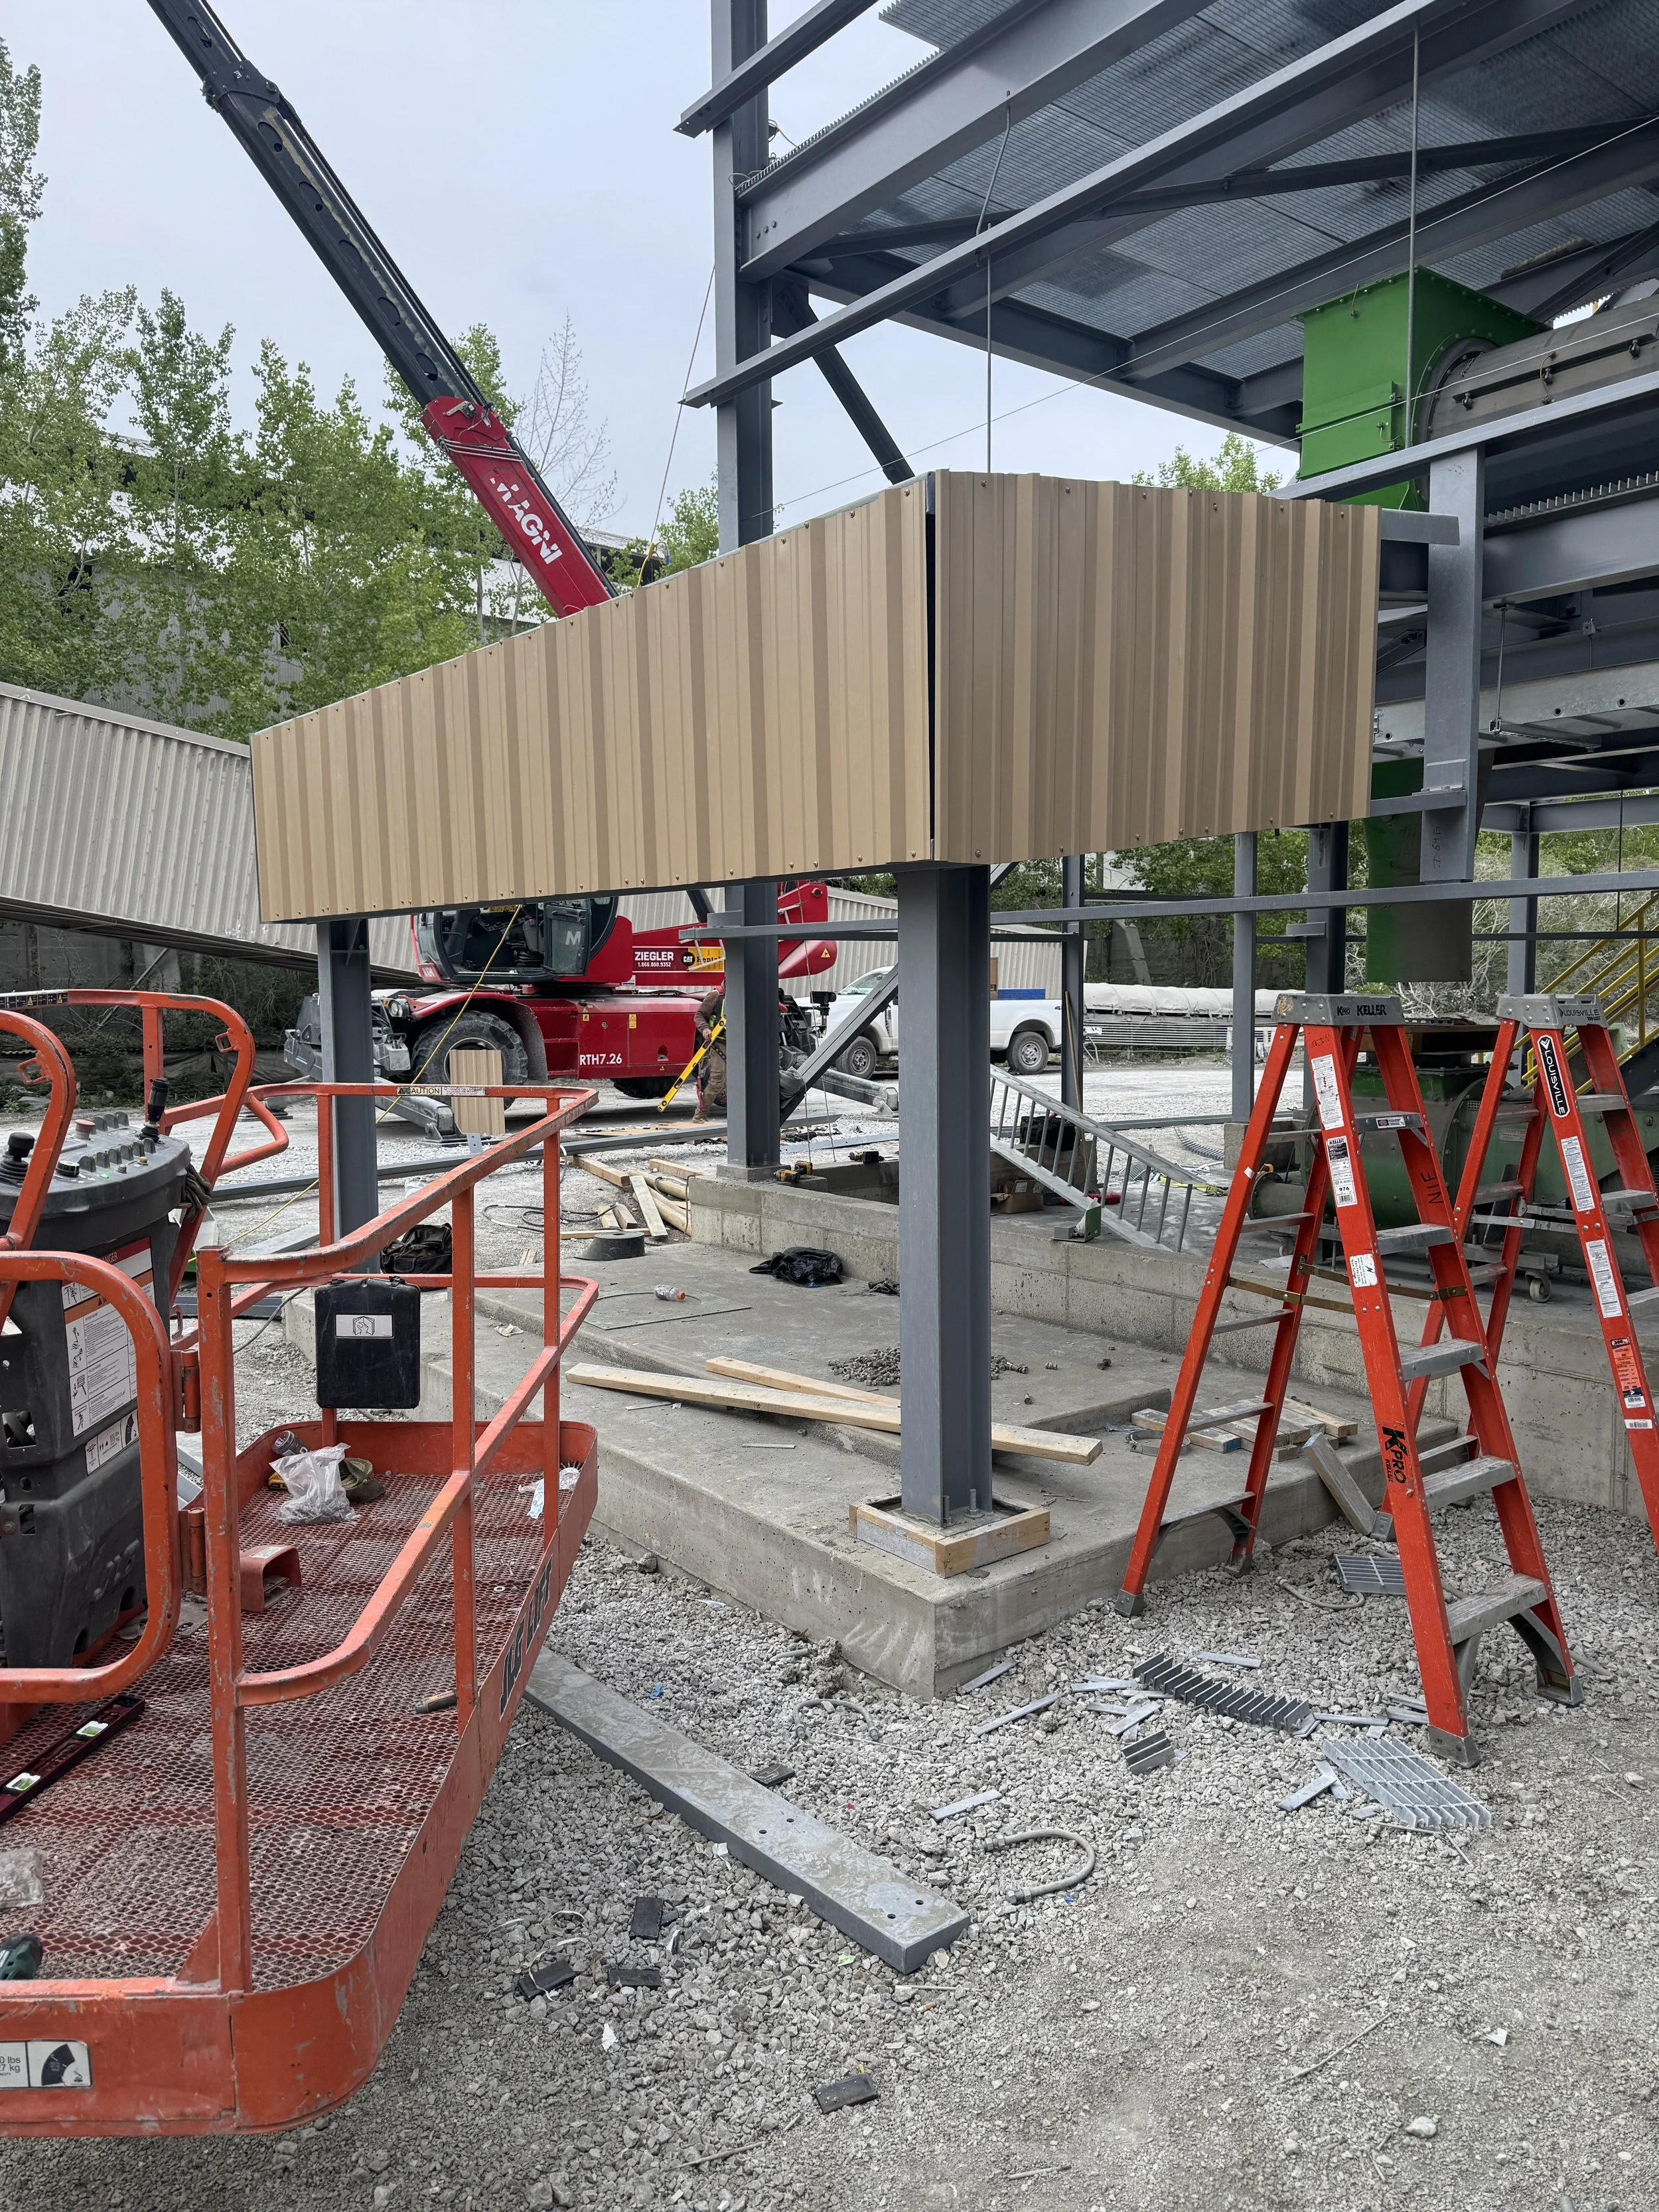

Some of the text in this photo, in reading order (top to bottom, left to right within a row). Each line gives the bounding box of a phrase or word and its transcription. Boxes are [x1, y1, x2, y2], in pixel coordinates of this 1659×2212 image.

[565, 930, 581, 945] M
[634, 952, 674, 961] ZIEGLER
[1356, 1004, 1387, 1016] KELLER
[579, 1053, 622, 1066] RTH7.26
[1544, 1050, 1565, 1115] LOUISVILLE
[1338, 1186, 1350, 1195] 976
[7, 2055, 21, 2064] lbs
[9, 2064, 21, 2073] kg
